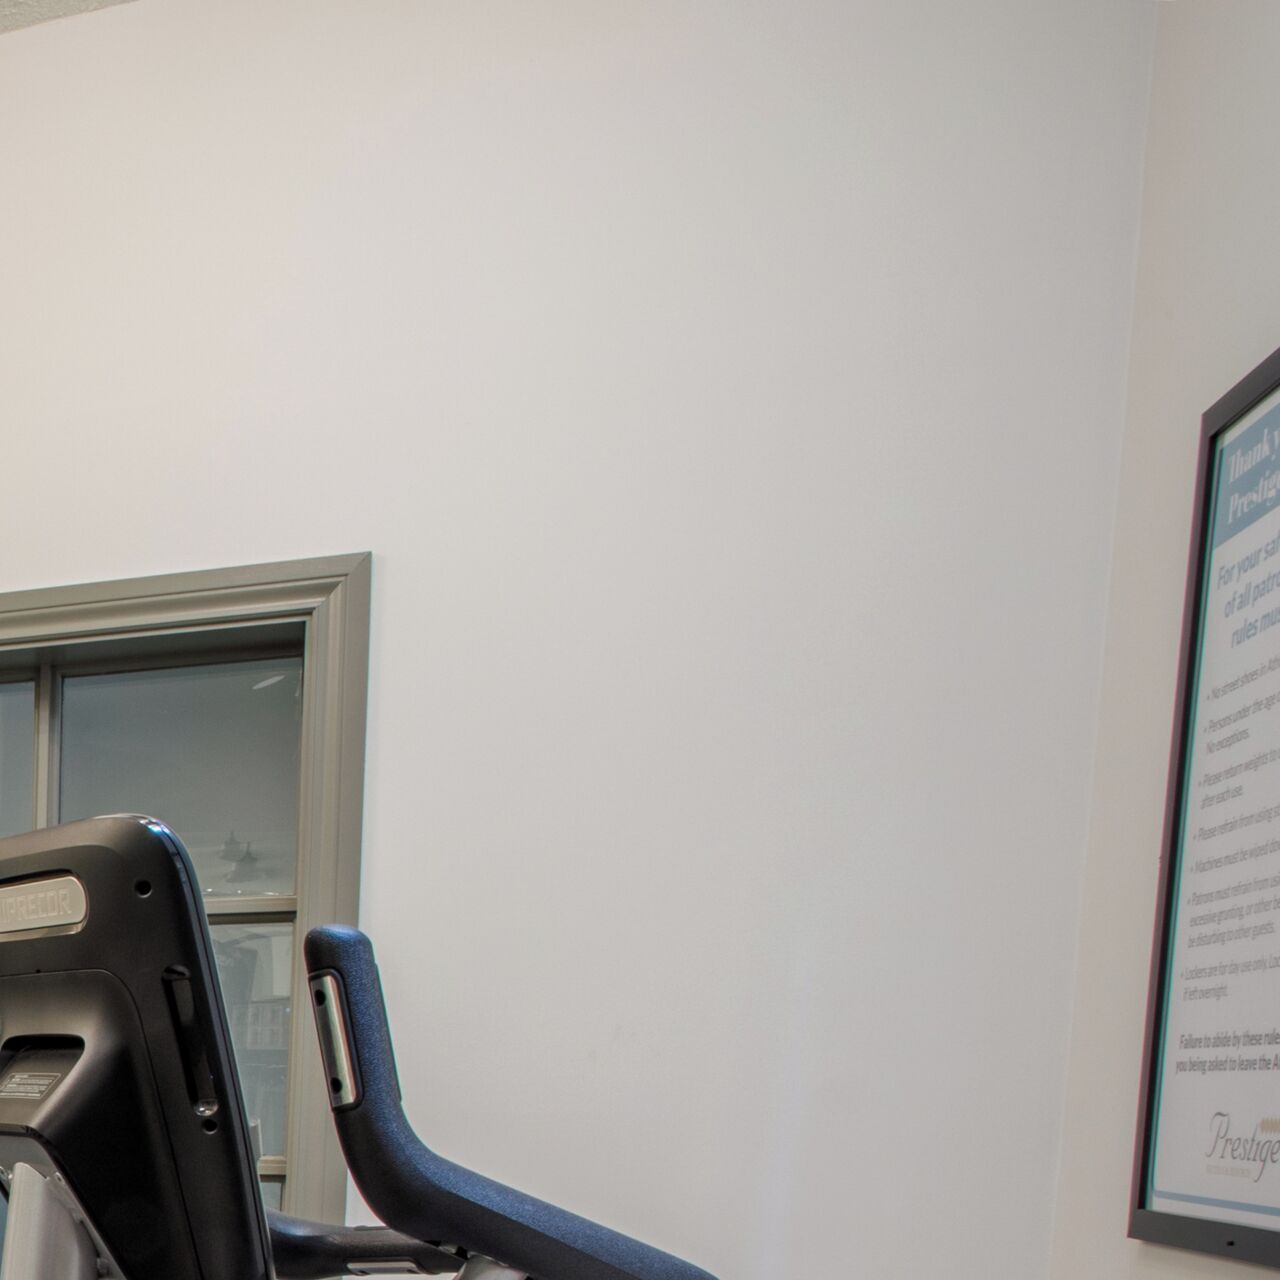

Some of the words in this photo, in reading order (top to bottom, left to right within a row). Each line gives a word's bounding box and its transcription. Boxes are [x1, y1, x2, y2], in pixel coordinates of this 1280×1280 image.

[1228, 427, 1271, 485] Thank
[1217, 562, 1236, 590] For
[1236, 547, 1261, 583] your
[1224, 590, 1238, 618] of
[1237, 581, 1252, 611] all
[1231, 617, 1259, 649] rules
[1180, 1032, 1202, 1050] Failure
[1203, 1034, 1211, 1048] to
[1212, 1031, 1231, 1048] abide
[1232, 1030, 1241, 1050] by
[1242, 1029, 1263, 1047] these
[1175, 1060, 1188, 1075] you
[1188, 1056, 1207, 1076] being
[1208, 1055, 1228, 1072] asked
[1228, 1056, 1237, 1072] to
[1237, 1054, 1257, 1072] leave
[1258, 1053, 1272, 1071] the
[1205, 1112, 1280, 1183] Prestige
